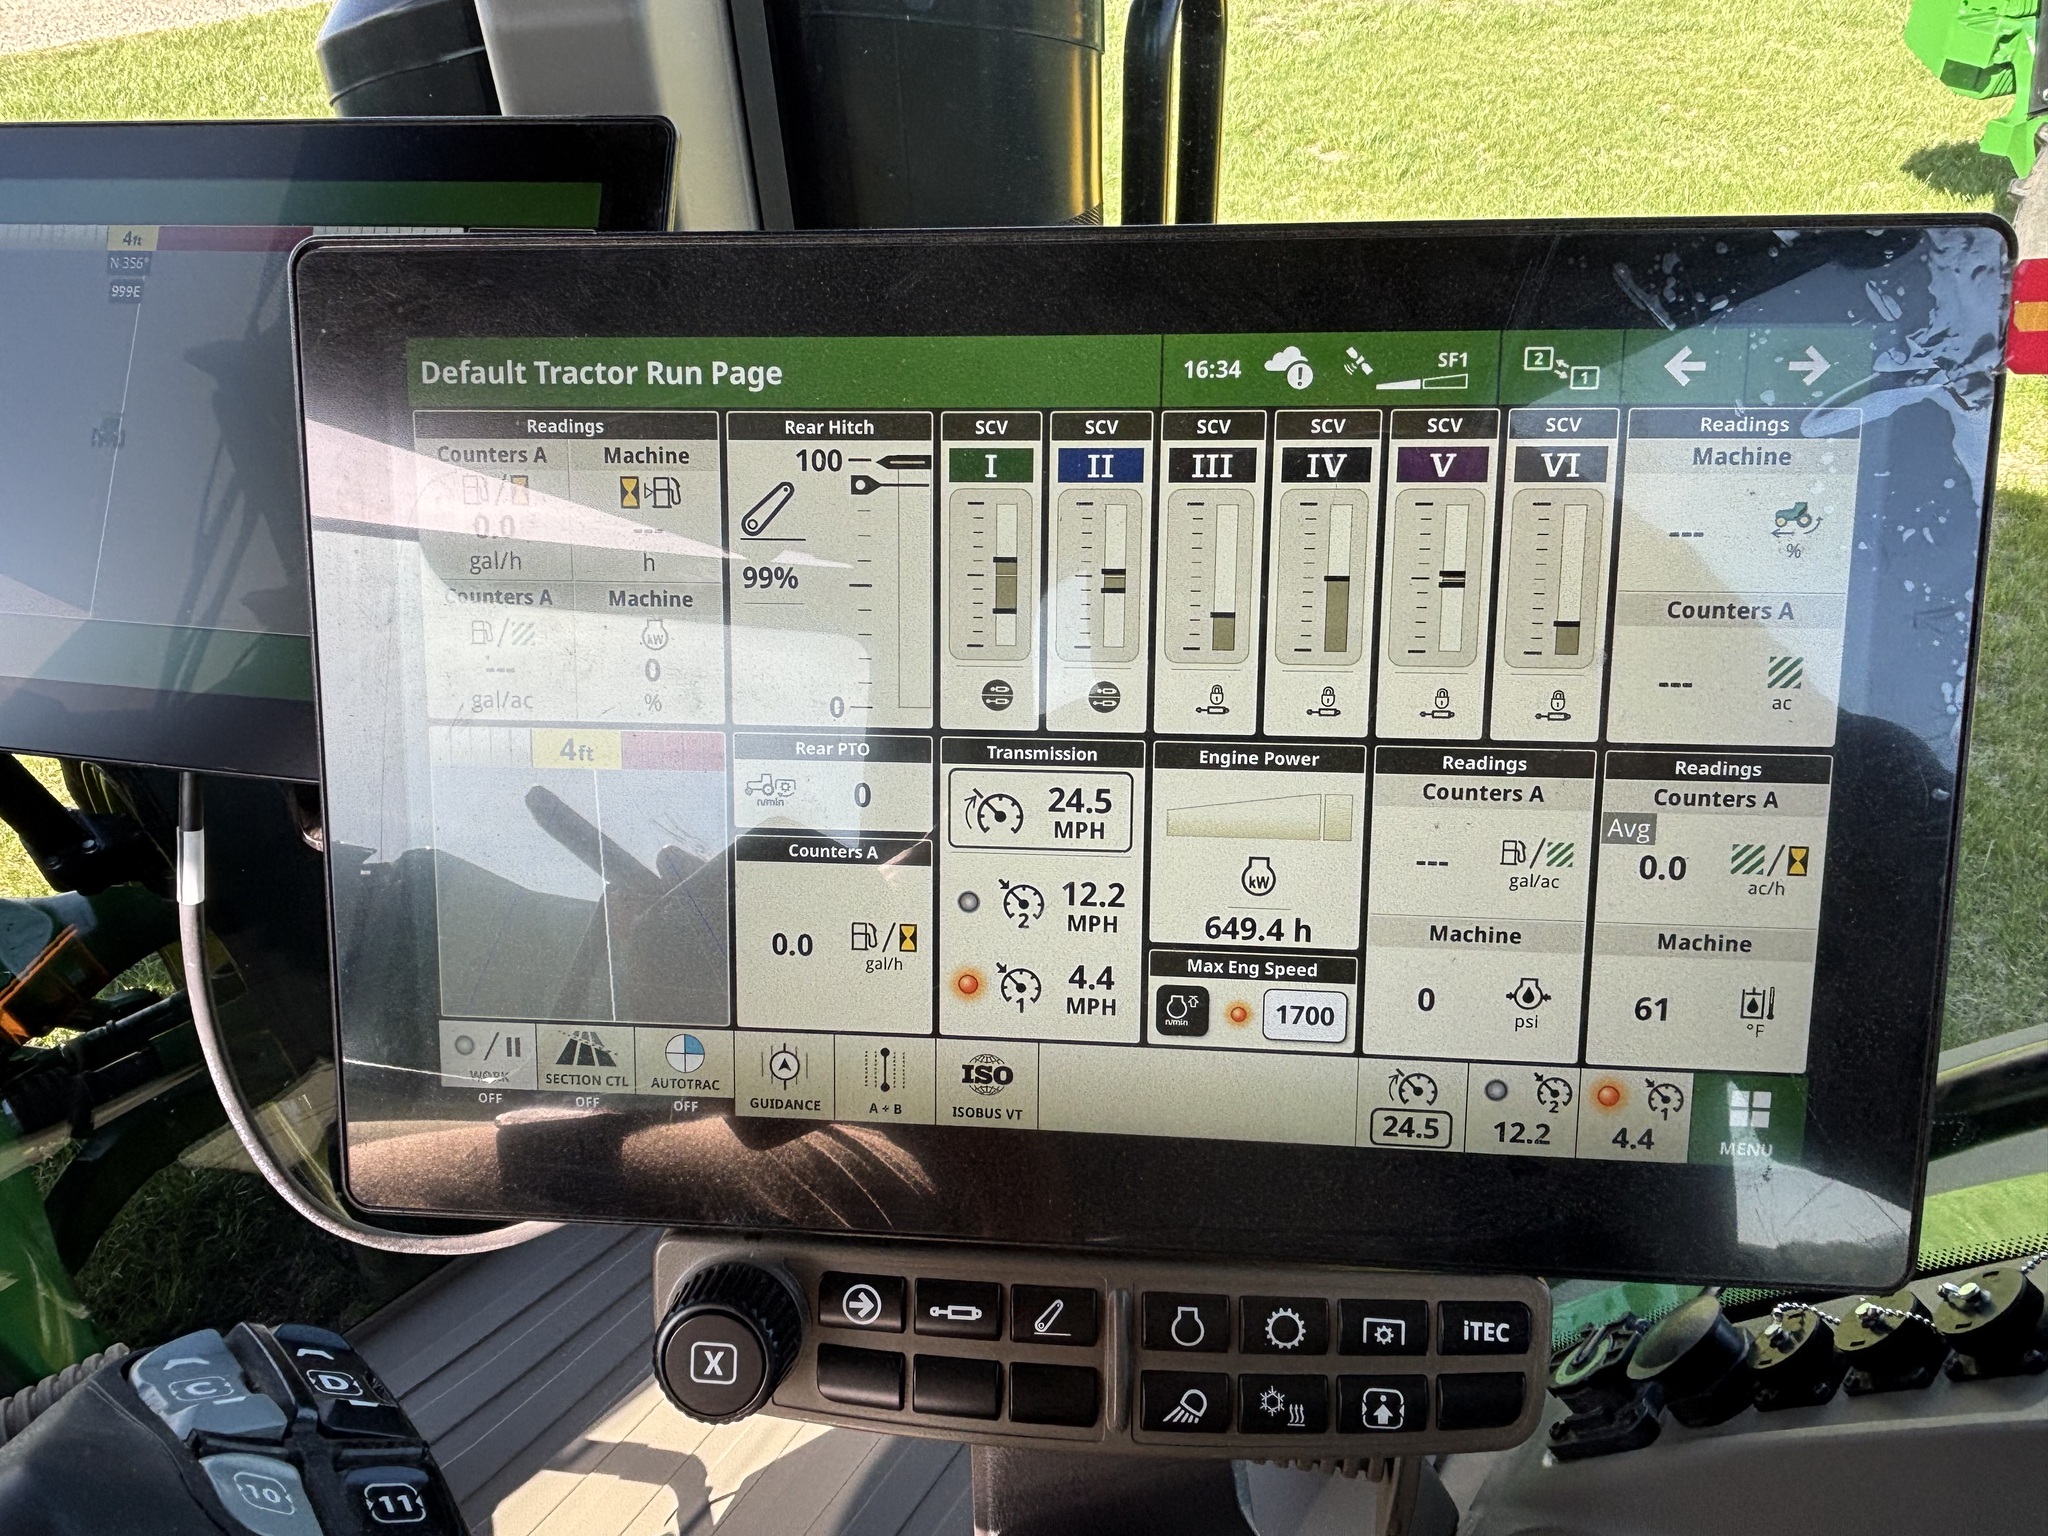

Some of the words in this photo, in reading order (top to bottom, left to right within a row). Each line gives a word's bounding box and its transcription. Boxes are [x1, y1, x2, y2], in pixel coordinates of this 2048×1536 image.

[1183, 360, 1242, 379] 16:34
[1437, 352, 1468, 368] SF1
[1534, 353, 1544, 366] 2
[420, 360, 528, 386] Default
[534, 361, 638, 386] Tractor
[647, 361, 702, 386] Run
[711, 361, 783, 392] Page
[1581, 371, 1589, 384] 1
[526, 418, 605, 436] Readings
[784, 419, 825, 436] Rear
[830, 419, 875, 436] Hitch
[974, 419, 1009, 436] SCV
[1084, 419, 1119, 436] SCV
[1196, 418, 1232, 434] SCV
[1310, 418, 1346, 434] SCV
[1427, 417, 1464, 433] SCV
[1545, 416, 1582, 433] SCV
[1700, 417, 1790, 437] Readings
[437, 446, 528, 464] Counters
[533, 446, 547, 464] A
[603, 447, 690, 465] Machine
[795, 449, 843, 472] 100
[1541, 452, 1581, 478] VI
[1692, 446, 1792, 467] Machine
[984, 453, 998, 478] I
[1087, 453, 1114, 479] II
[1191, 453, 1233, 478] III
[1306, 453, 1348, 478] IV
[1429, 453, 1457, 478] V
[474, 514, 516, 539] 0.0
[469, 551, 522, 575] gal/h
[643, 554, 656, 572] h
[742, 566, 799, 590] 99%
[539, 589, 553, 606] A
[608, 589, 694, 609] Machine
[1667, 600, 1772, 621] Counters
[1778, 601, 1795, 621] A
[645, 658, 661, 683] 0
[471, 690, 534, 713] gal/ac
[645, 693, 662, 712] %
[830, 695, 845, 719] 0
[1771, 698, 1792, 711] ac
[795, 741, 834, 756] Rear
[838, 742, 871, 757] PTO
[987, 745, 1098, 762] Transmission
[1199, 750, 1259, 770] Engine
[1264, 751, 1320, 769] Power
[1442, 754, 1528, 773] Readings
[1675, 760, 1763, 779] Readings
[854, 783, 872, 808] 0
[1048, 787, 1112, 814] 24.5
[1422, 782, 1522, 803] Counters
[1529, 785, 1544, 803] A
[1653, 787, 1757, 808] Counters
[1762, 790, 1779, 809] A
[1054, 821, 1105, 840] MPH
[1607, 818, 1651, 843] Avg
[788, 843, 862, 860] Counters
[866, 845, 879, 860] A
[1639, 854, 1687, 881] 0.0
[1249, 876, 1270, 889] kW
[1508, 873, 1560, 891] gal/ac
[1747, 880, 1786, 897] ac/h
[1062, 881, 1126, 908] 12.2
[1067, 914, 1118, 934] MPH
[1205, 916, 1285, 942] 649.4
[1294, 917, 1312, 942] h
[772, 932, 814, 956] 0.0
[1429, 925, 1522, 945] Machine
[1657, 933, 1752, 954] Machine
[865, 957, 903, 973] gal/h
[1187, 958, 1224, 974] Max
[1228, 960, 1259, 978] Eng
[1264, 962, 1318, 978] Speed
[1068, 965, 1115, 991] 4.4
[1066, 997, 1117, 1016] MPH
[1418, 988, 1435, 1012] 0
[1634, 996, 1668, 1022] 61
[1276, 1004, 1335, 1027] 1700
[1514, 1015, 1539, 1031] psi
[546, 1073, 602, 1087] SECTION
[606, 1075, 630, 1088] CTL
[651, 1077, 721, 1092] AUTOTRAC
[962, 1064, 1014, 1086] ISO
[478, 1092, 502, 1104] OFF
[575, 1096, 600, 1108] OFF
[673, 1100, 698, 1112] OFF
[749, 1097, 821, 1112] GUIDANCE
[869, 1103, 878, 1114] A
[893, 1104, 902, 1115] B
[952, 1105, 1002, 1120] ISOBUS
[1005, 1108, 1023, 1121] VT
[1383, 1116, 1440, 1140] 24.5
[1493, 1121, 1550, 1145] 12.2
[1612, 1127, 1655, 1150] 4.4
[1720, 1141, 1773, 1157] MENU
[1463, 1319, 1511, 1343] iTEC
[184, 1381, 218, 1396] C
[317, 1373, 349, 1391] D
[245, 1483, 282, 1504] 10
[378, 1494, 414, 1514] 11
